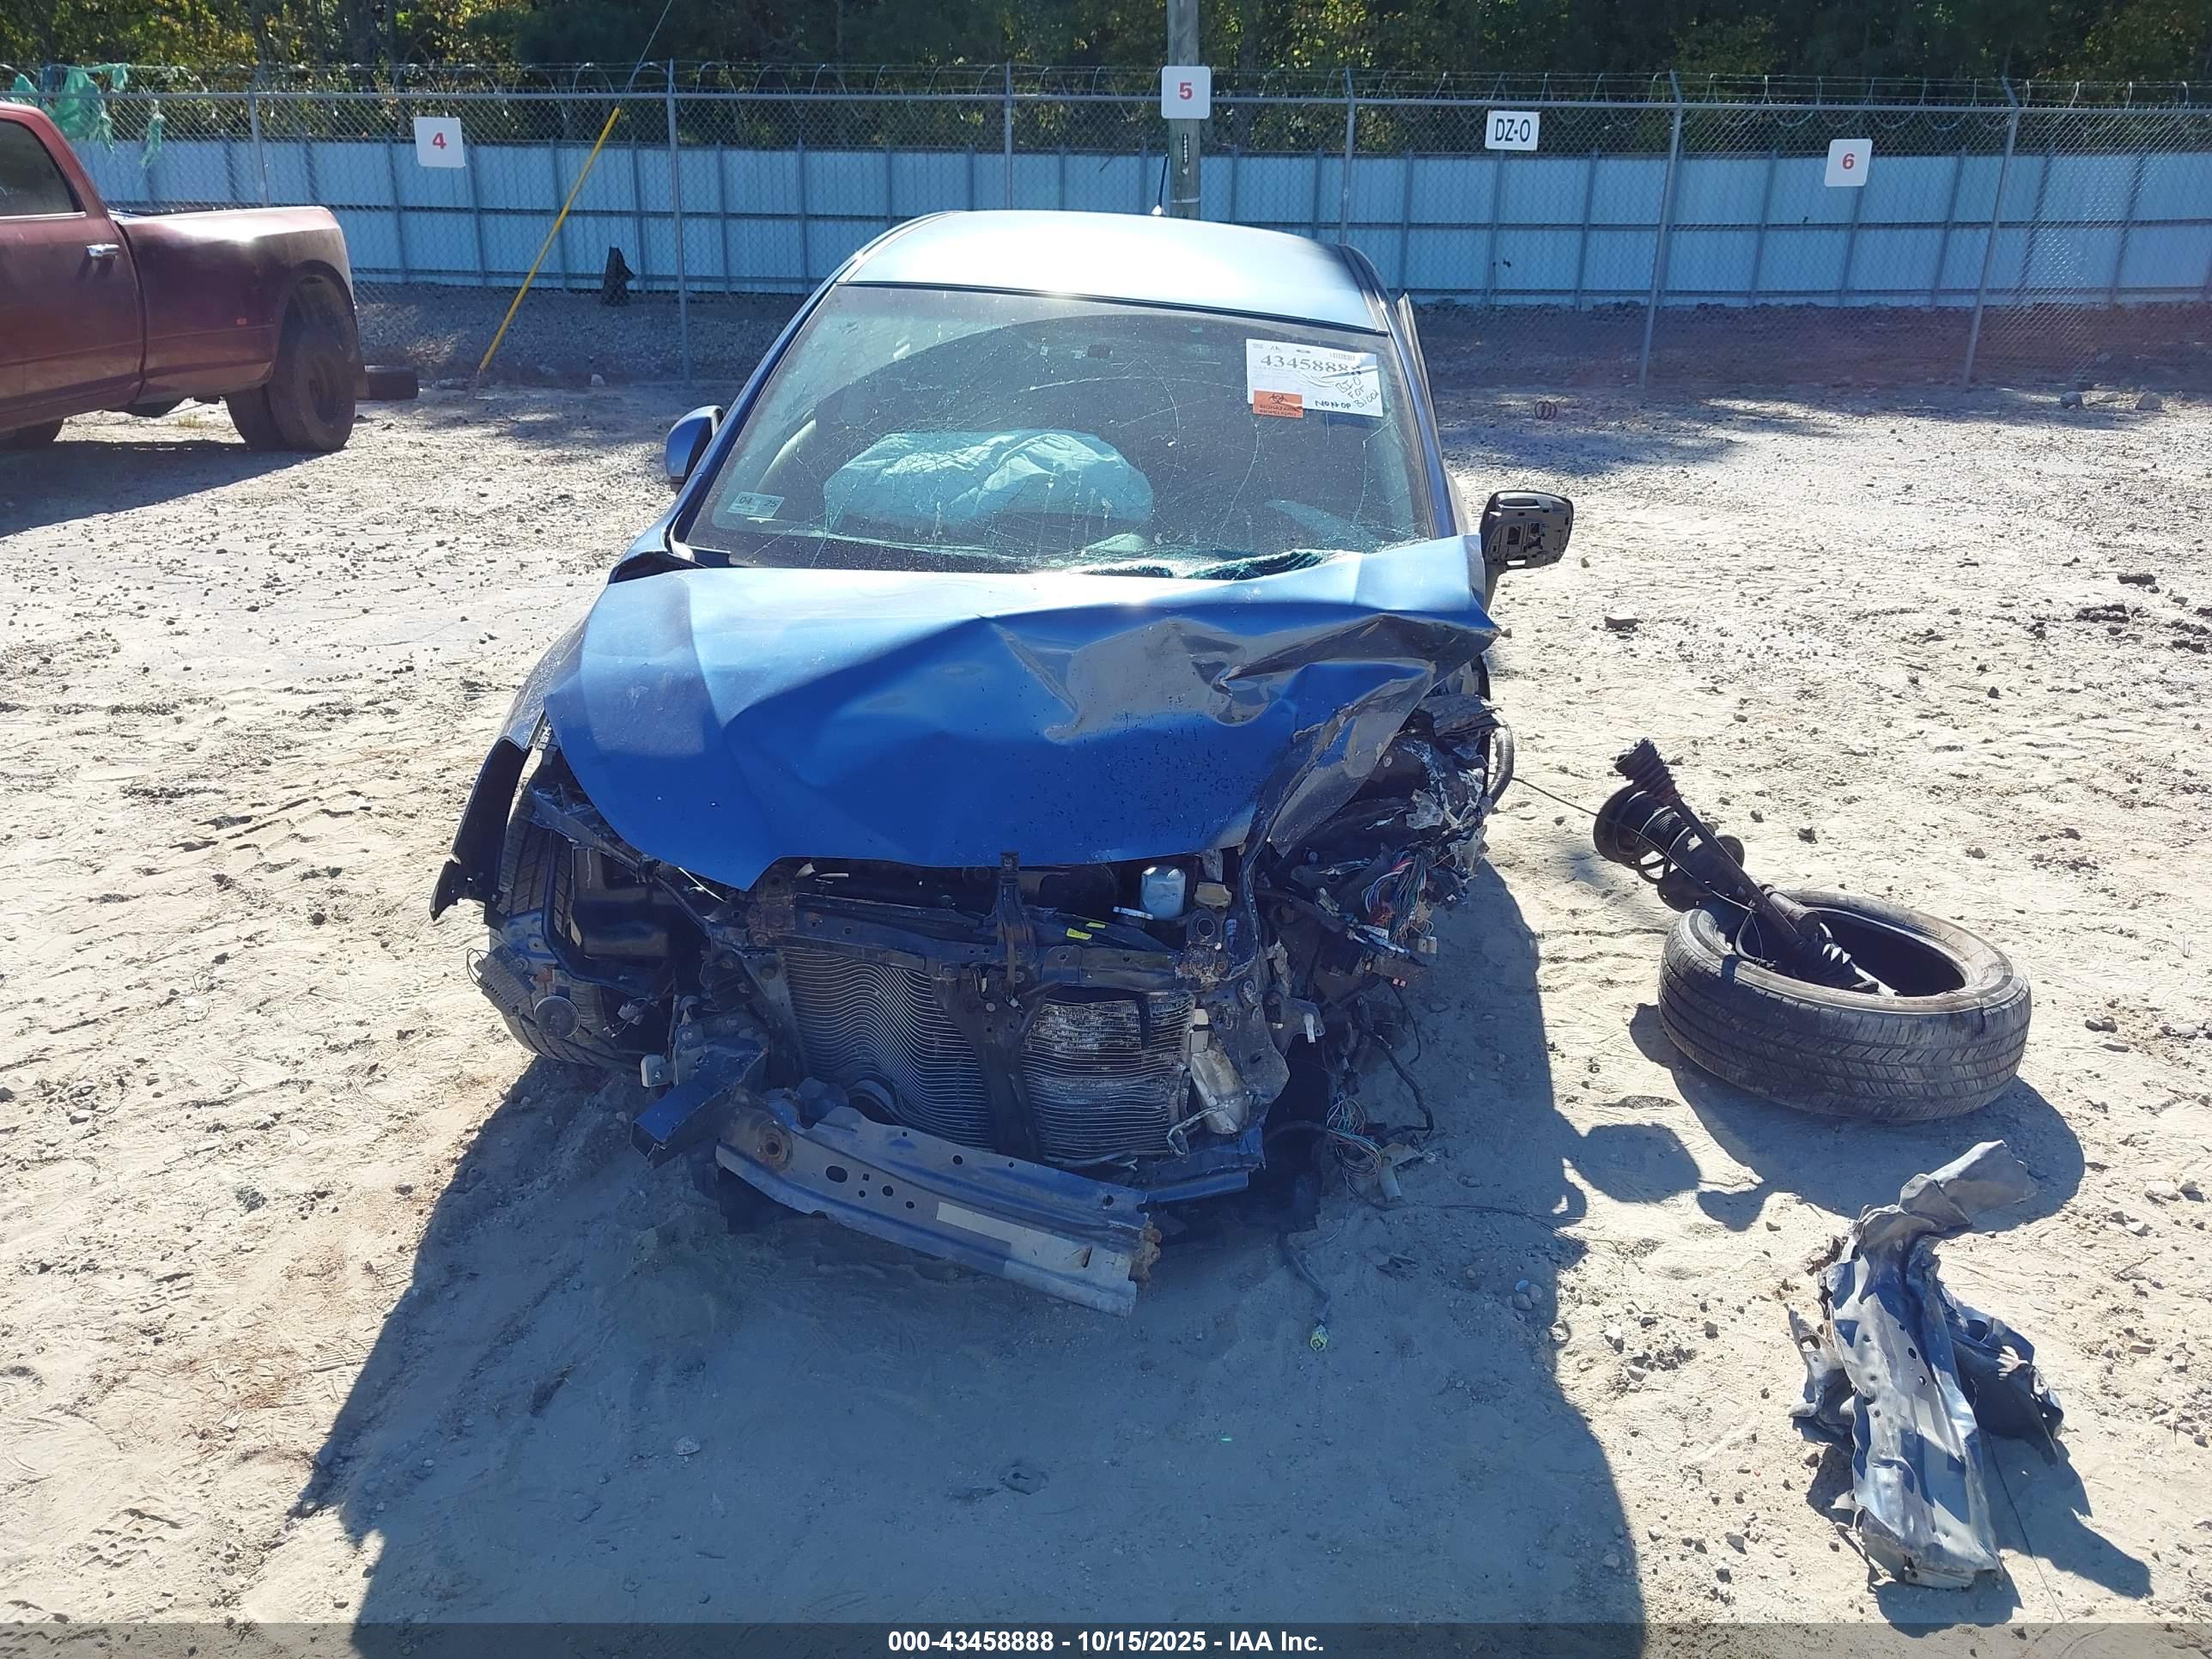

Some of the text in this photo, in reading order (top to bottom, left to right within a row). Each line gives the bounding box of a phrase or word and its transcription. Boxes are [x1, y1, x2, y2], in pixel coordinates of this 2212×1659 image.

[1179, 82, 1193, 100] 5
[432, 132, 447, 149] 4
[1842, 153, 1856, 170] 6
